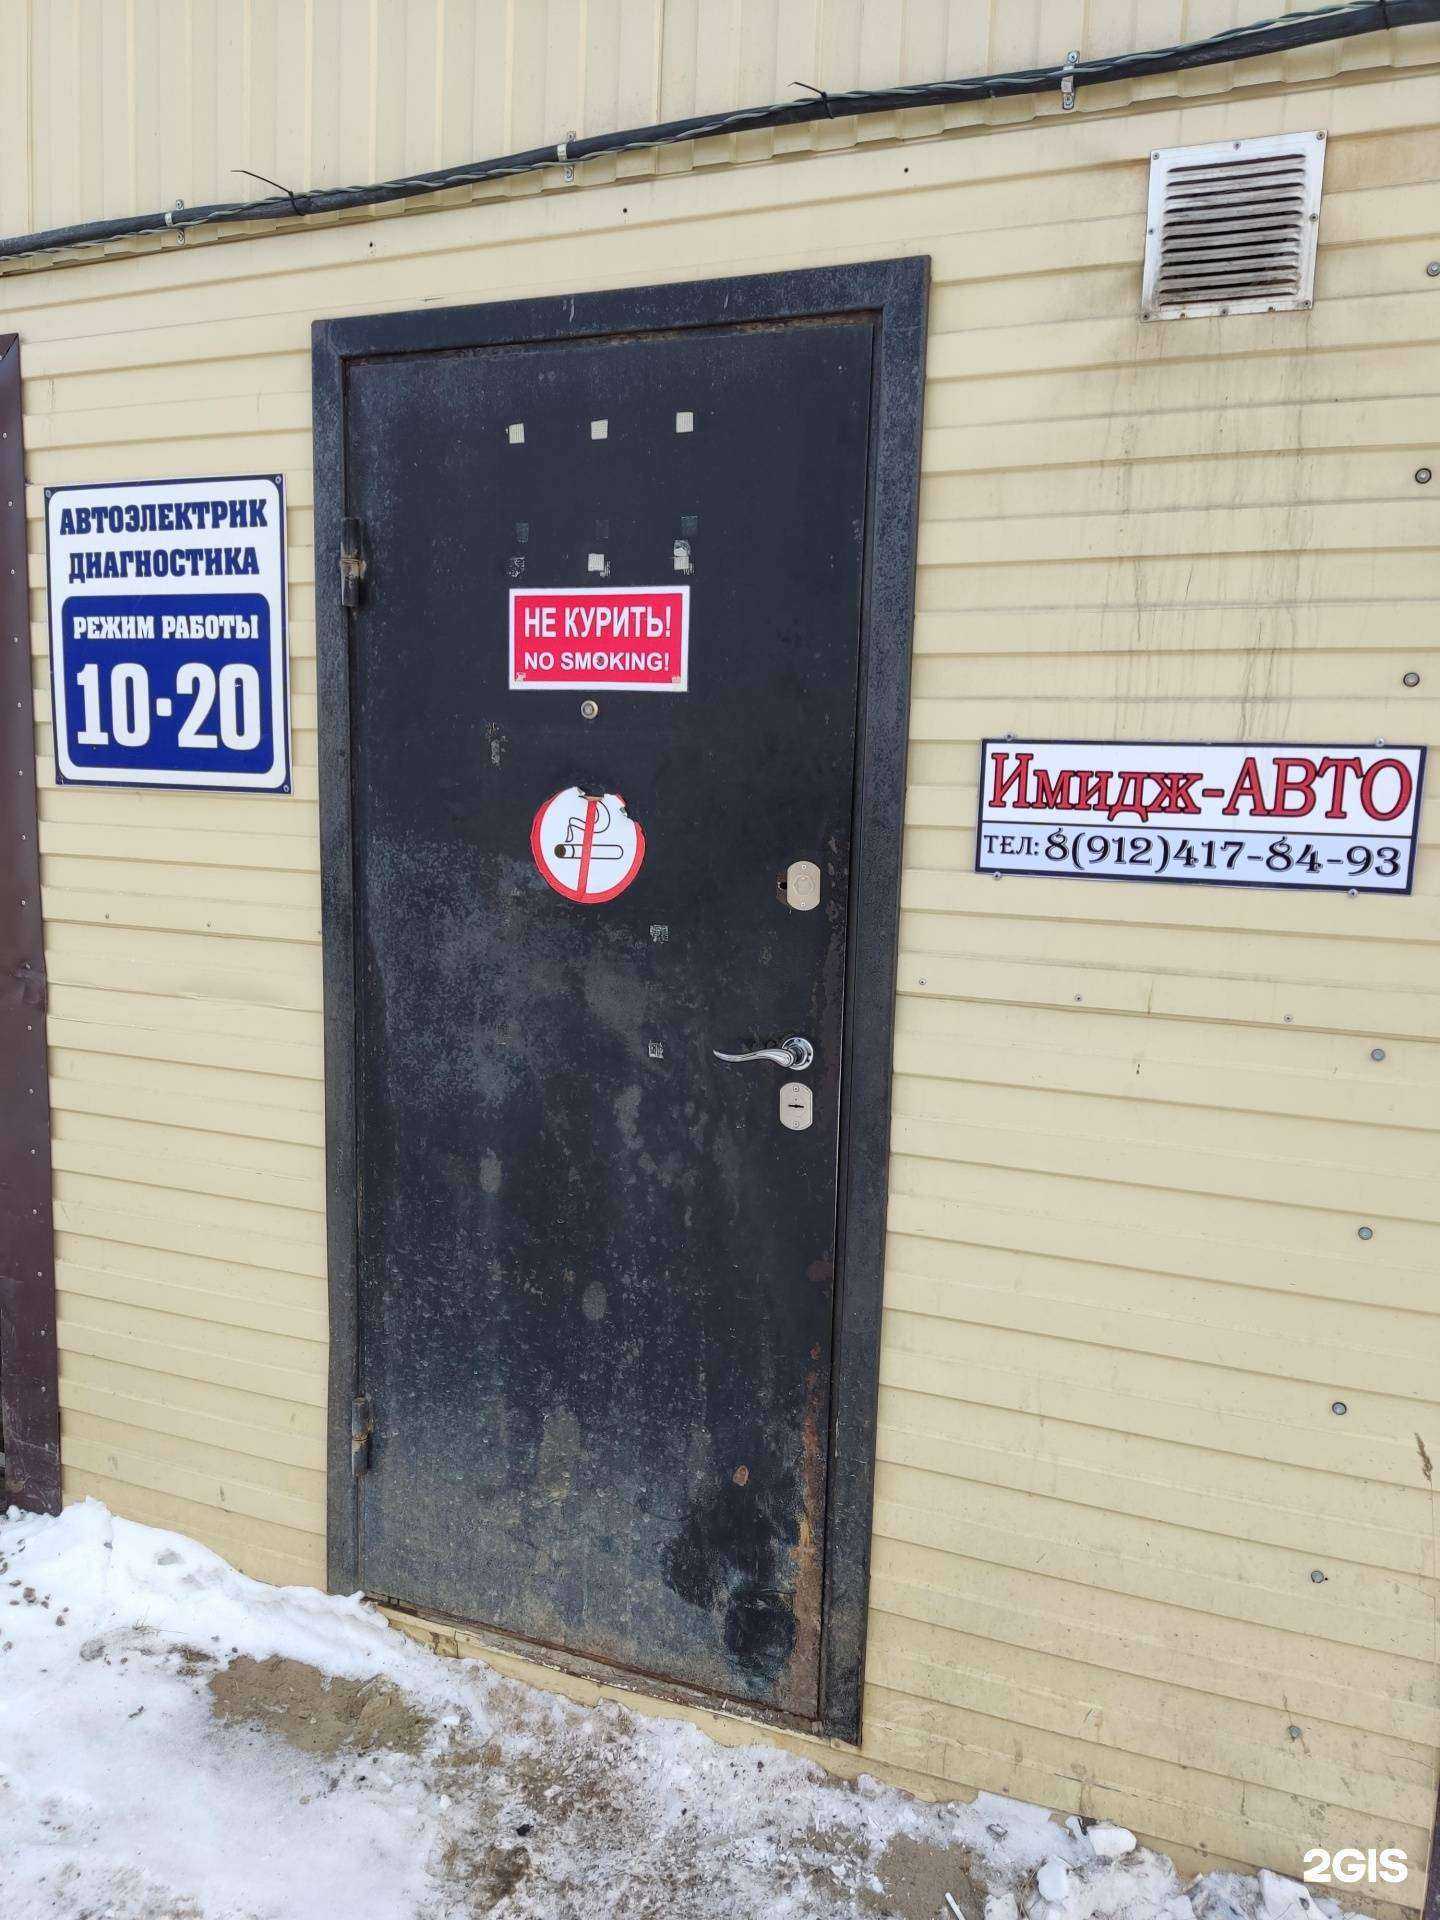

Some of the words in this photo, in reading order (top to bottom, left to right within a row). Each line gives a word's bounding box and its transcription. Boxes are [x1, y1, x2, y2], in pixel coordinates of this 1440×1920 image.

[59, 499, 268, 535] АВТОЭЛЕКТРИК
[69, 547, 260, 584] ДИАГНОСТИКА
[73, 615, 155, 640] РЕЖИМ
[162, 614, 259, 639] РАБОТЫ
[524, 607, 557, 638] НЕ
[564, 606, 672, 638] КУРИТЬ!
[524, 651, 555, 671] NO
[560, 651, 670, 672] SMOKING!
[988, 752, 1413, 823] Имидж-АВТО
